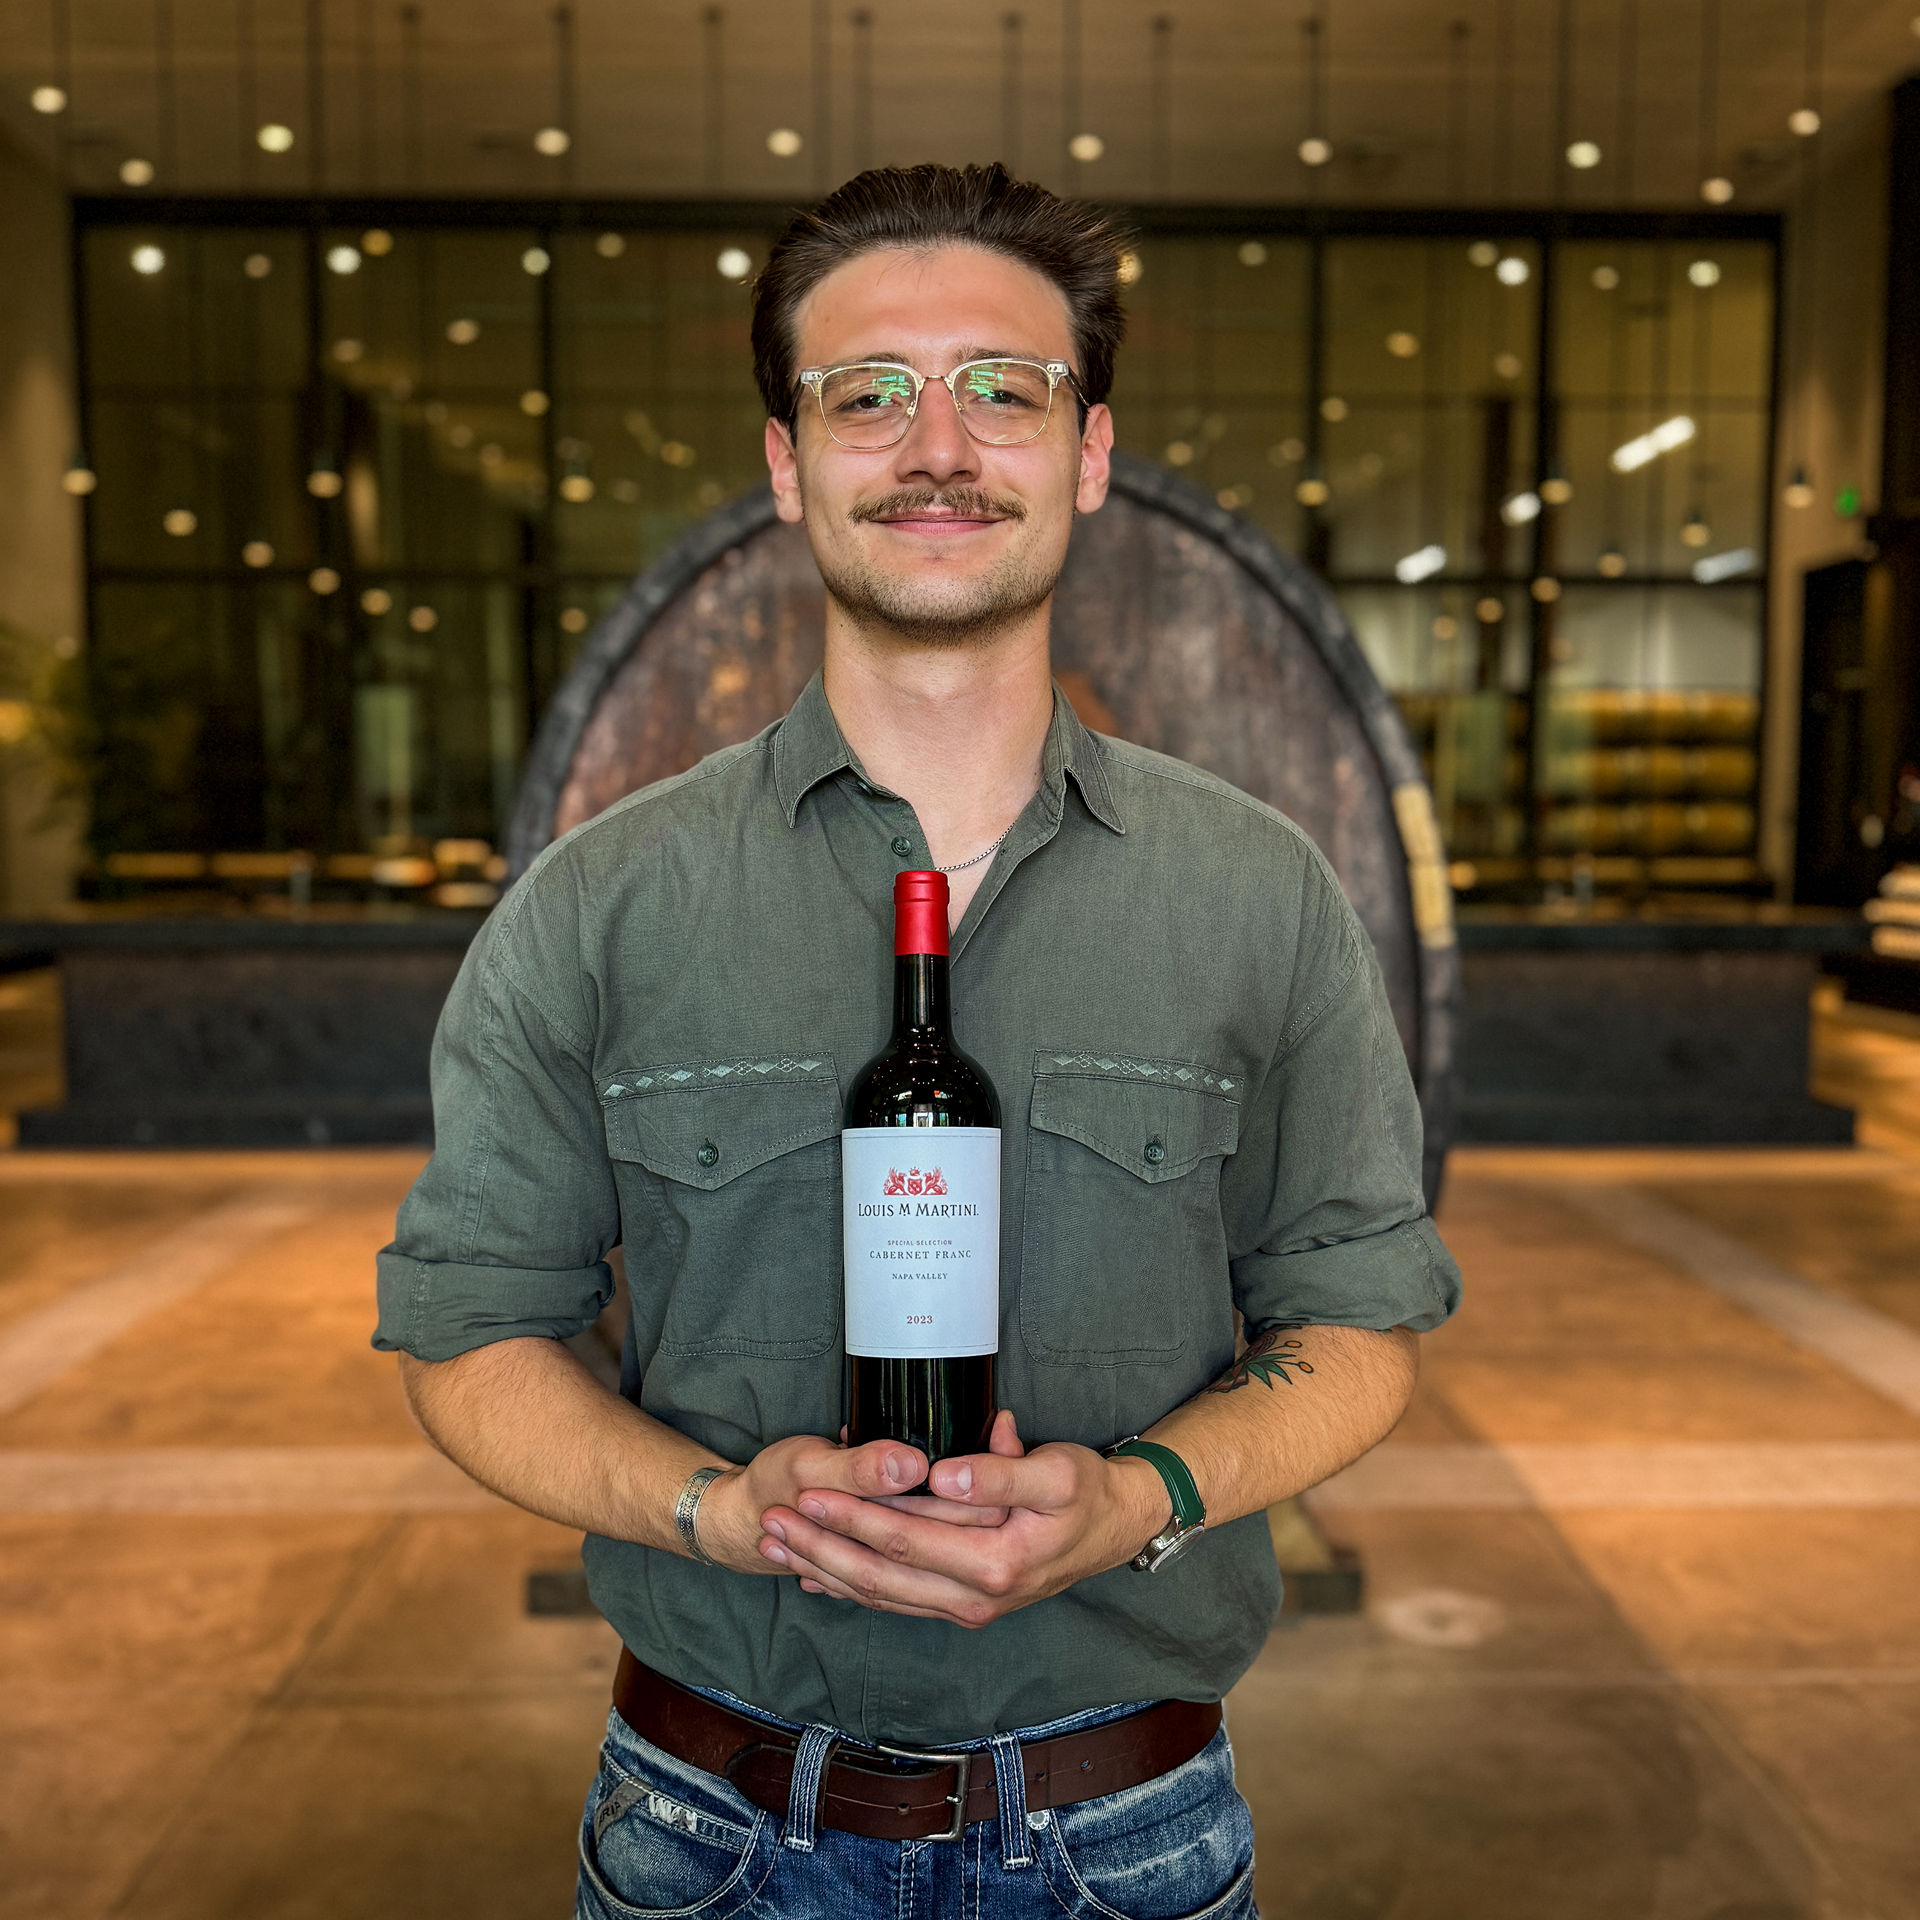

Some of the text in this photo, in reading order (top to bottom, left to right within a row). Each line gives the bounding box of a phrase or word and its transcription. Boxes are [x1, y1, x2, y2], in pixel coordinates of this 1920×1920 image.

[858, 1203, 894, 1217] LOUIS
[869, 1249, 972, 1260] CABERNET FRANC
[915, 1272, 948, 1280] VALLEY
[906, 1315, 933, 1325] 2023
